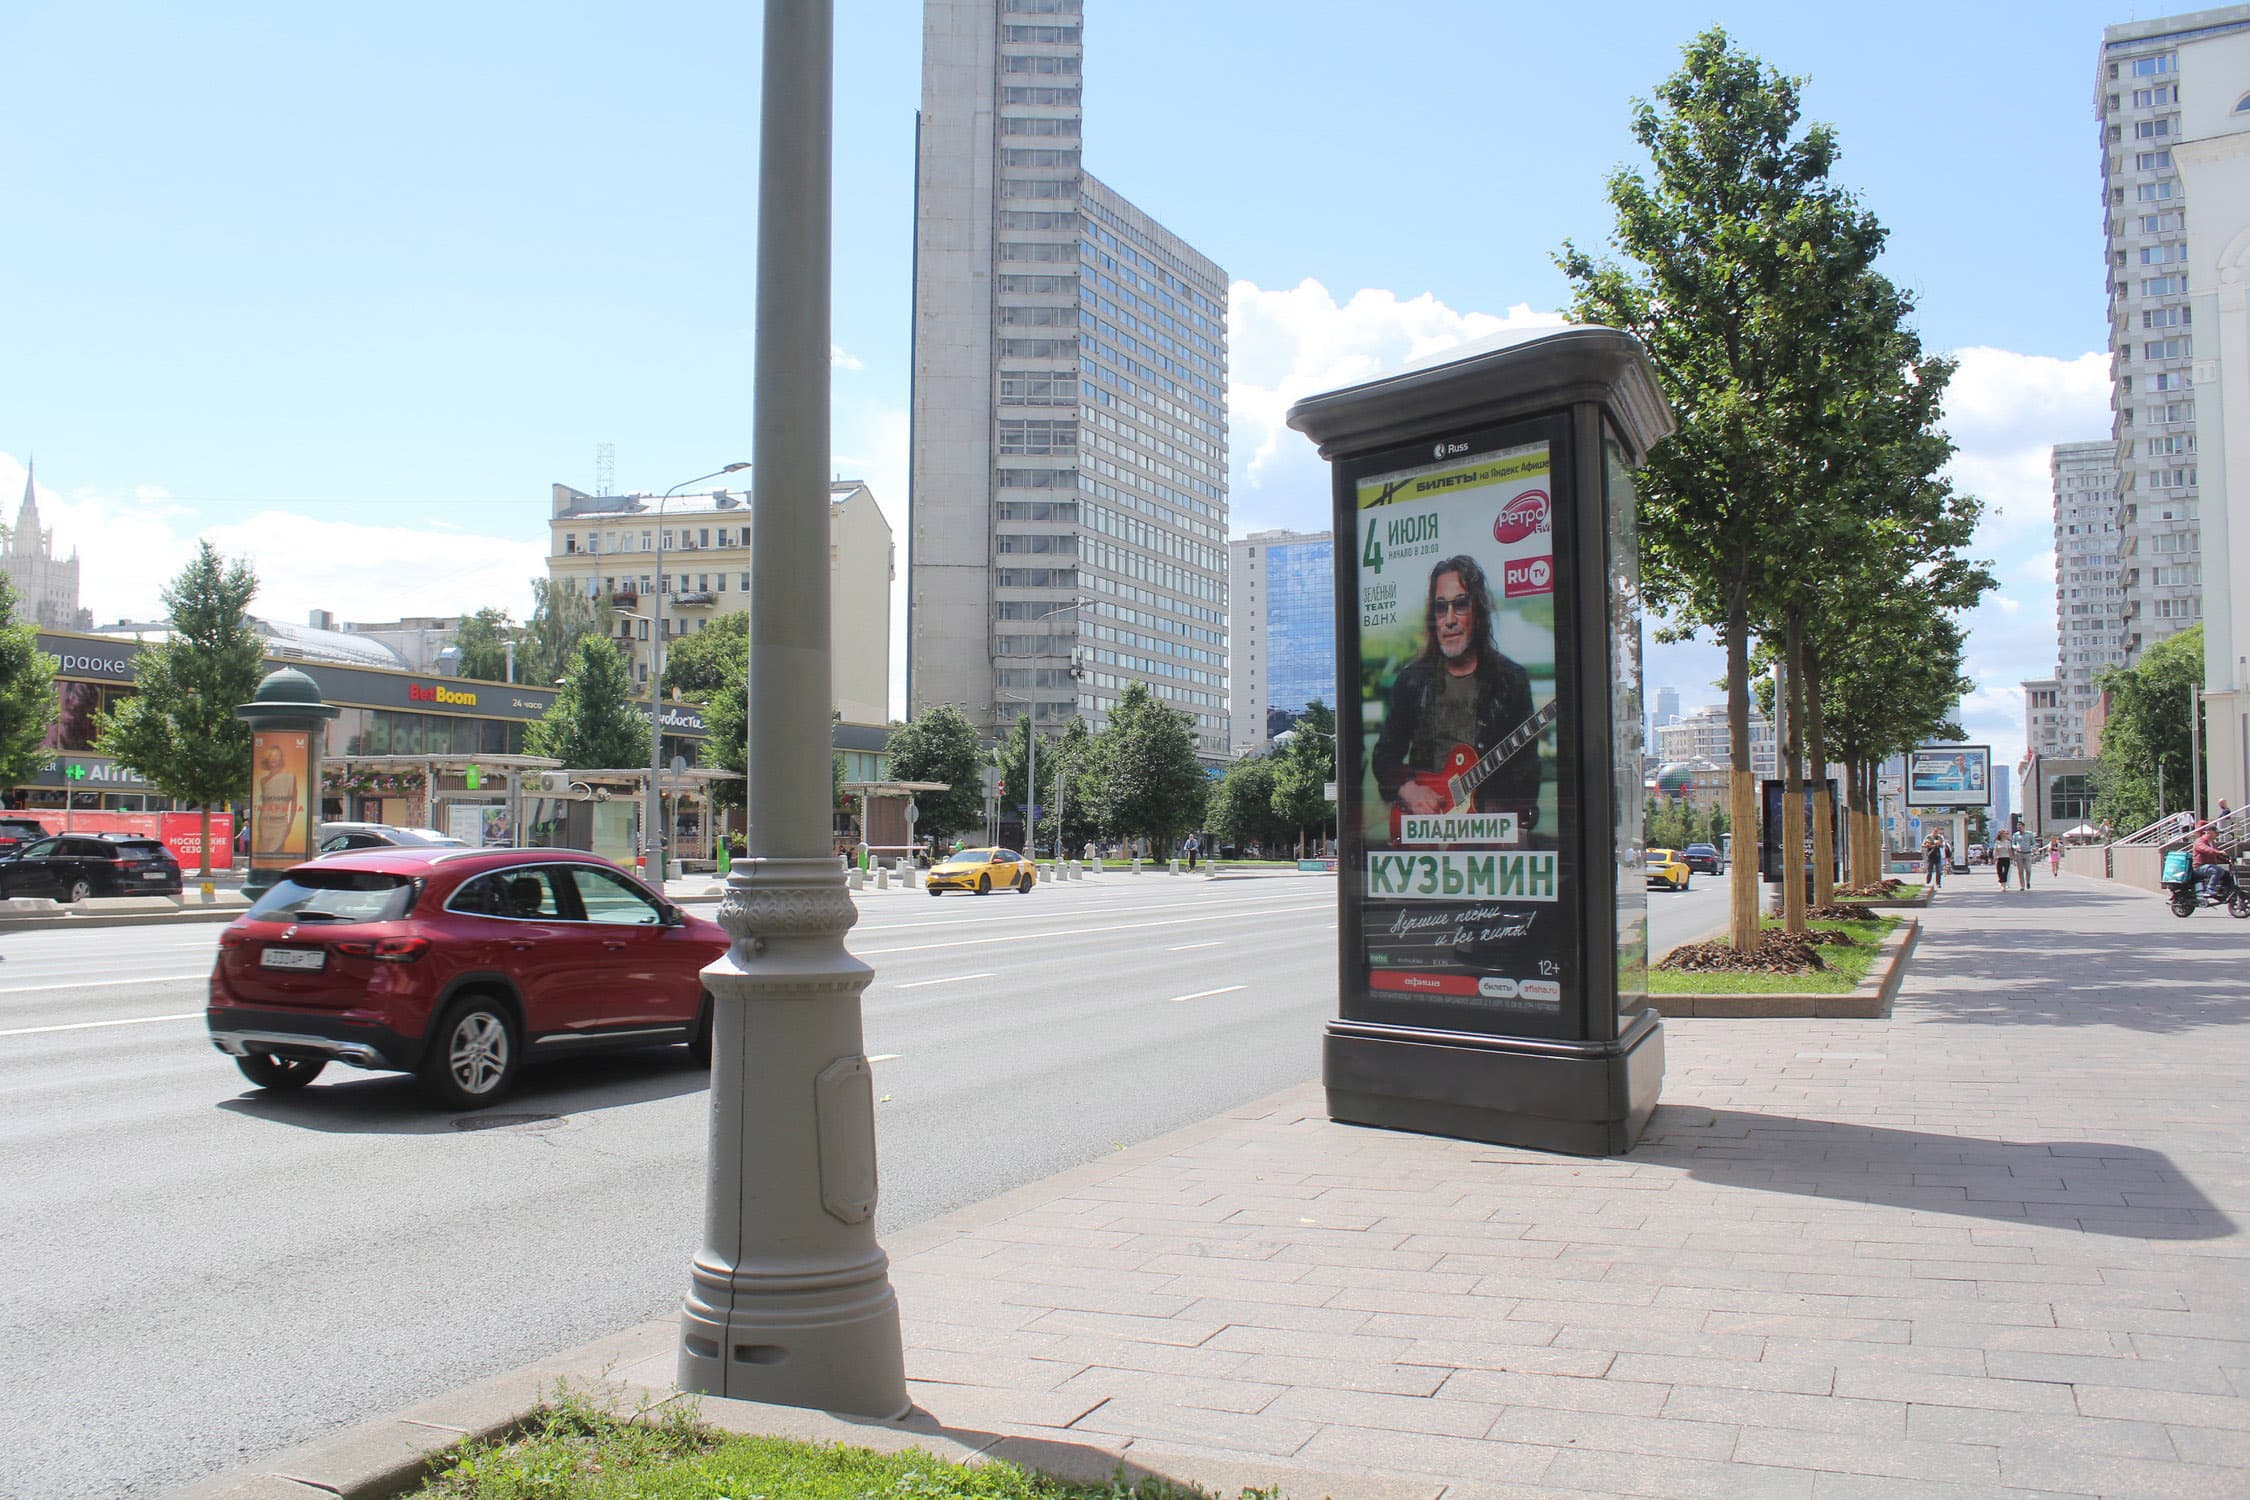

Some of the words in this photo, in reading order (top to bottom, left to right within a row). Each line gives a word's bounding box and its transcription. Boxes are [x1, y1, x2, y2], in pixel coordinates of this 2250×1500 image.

[1448, 443, 1469, 454] Russ
[1416, 472, 1476, 492] БИЛЕТЫ
[1480, 471, 1489, 480] на
[1491, 465, 1520, 479] Яндекс
[1520, 460, 1550, 474] Афише
[1498, 507, 1546, 528] Ретро
[1363, 518, 1384, 574] 4
[1388, 512, 1438, 546] ИЮЛЯ
[1388, 547, 1412, 560] НАЧАЛО
[1421, 543, 1439, 555] 20:00
[1364, 600, 1396, 611] ТЕАТР
[1363, 612, 1397, 627] ВДНХ
[50, 654, 125, 673] араоке
[409, 684, 477, 706] BetBoom
[512, 698, 522, 707] 24
[89, 764, 147, 783] АПТЕ
[1407, 818, 1511, 841] ВЛАДИМИР
[170, 837, 227, 845] МОСКОКИЕ
[180, 846, 215, 854] СЕЗОЫ
[1371, 855, 1554, 896] КУЗЬМИН
[1390, 908, 1449, 938] Лучшие
[1455, 905, 1501, 923] песни
[1434, 935, 1447, 946] и
[1452, 926, 1474, 945] все
[1538, 959, 1561, 976] 12+
[1404, 977, 1441, 988] афиша
[1483, 982, 1513, 992] билеты
[1523, 984, 1558, 995] afisha.ru
